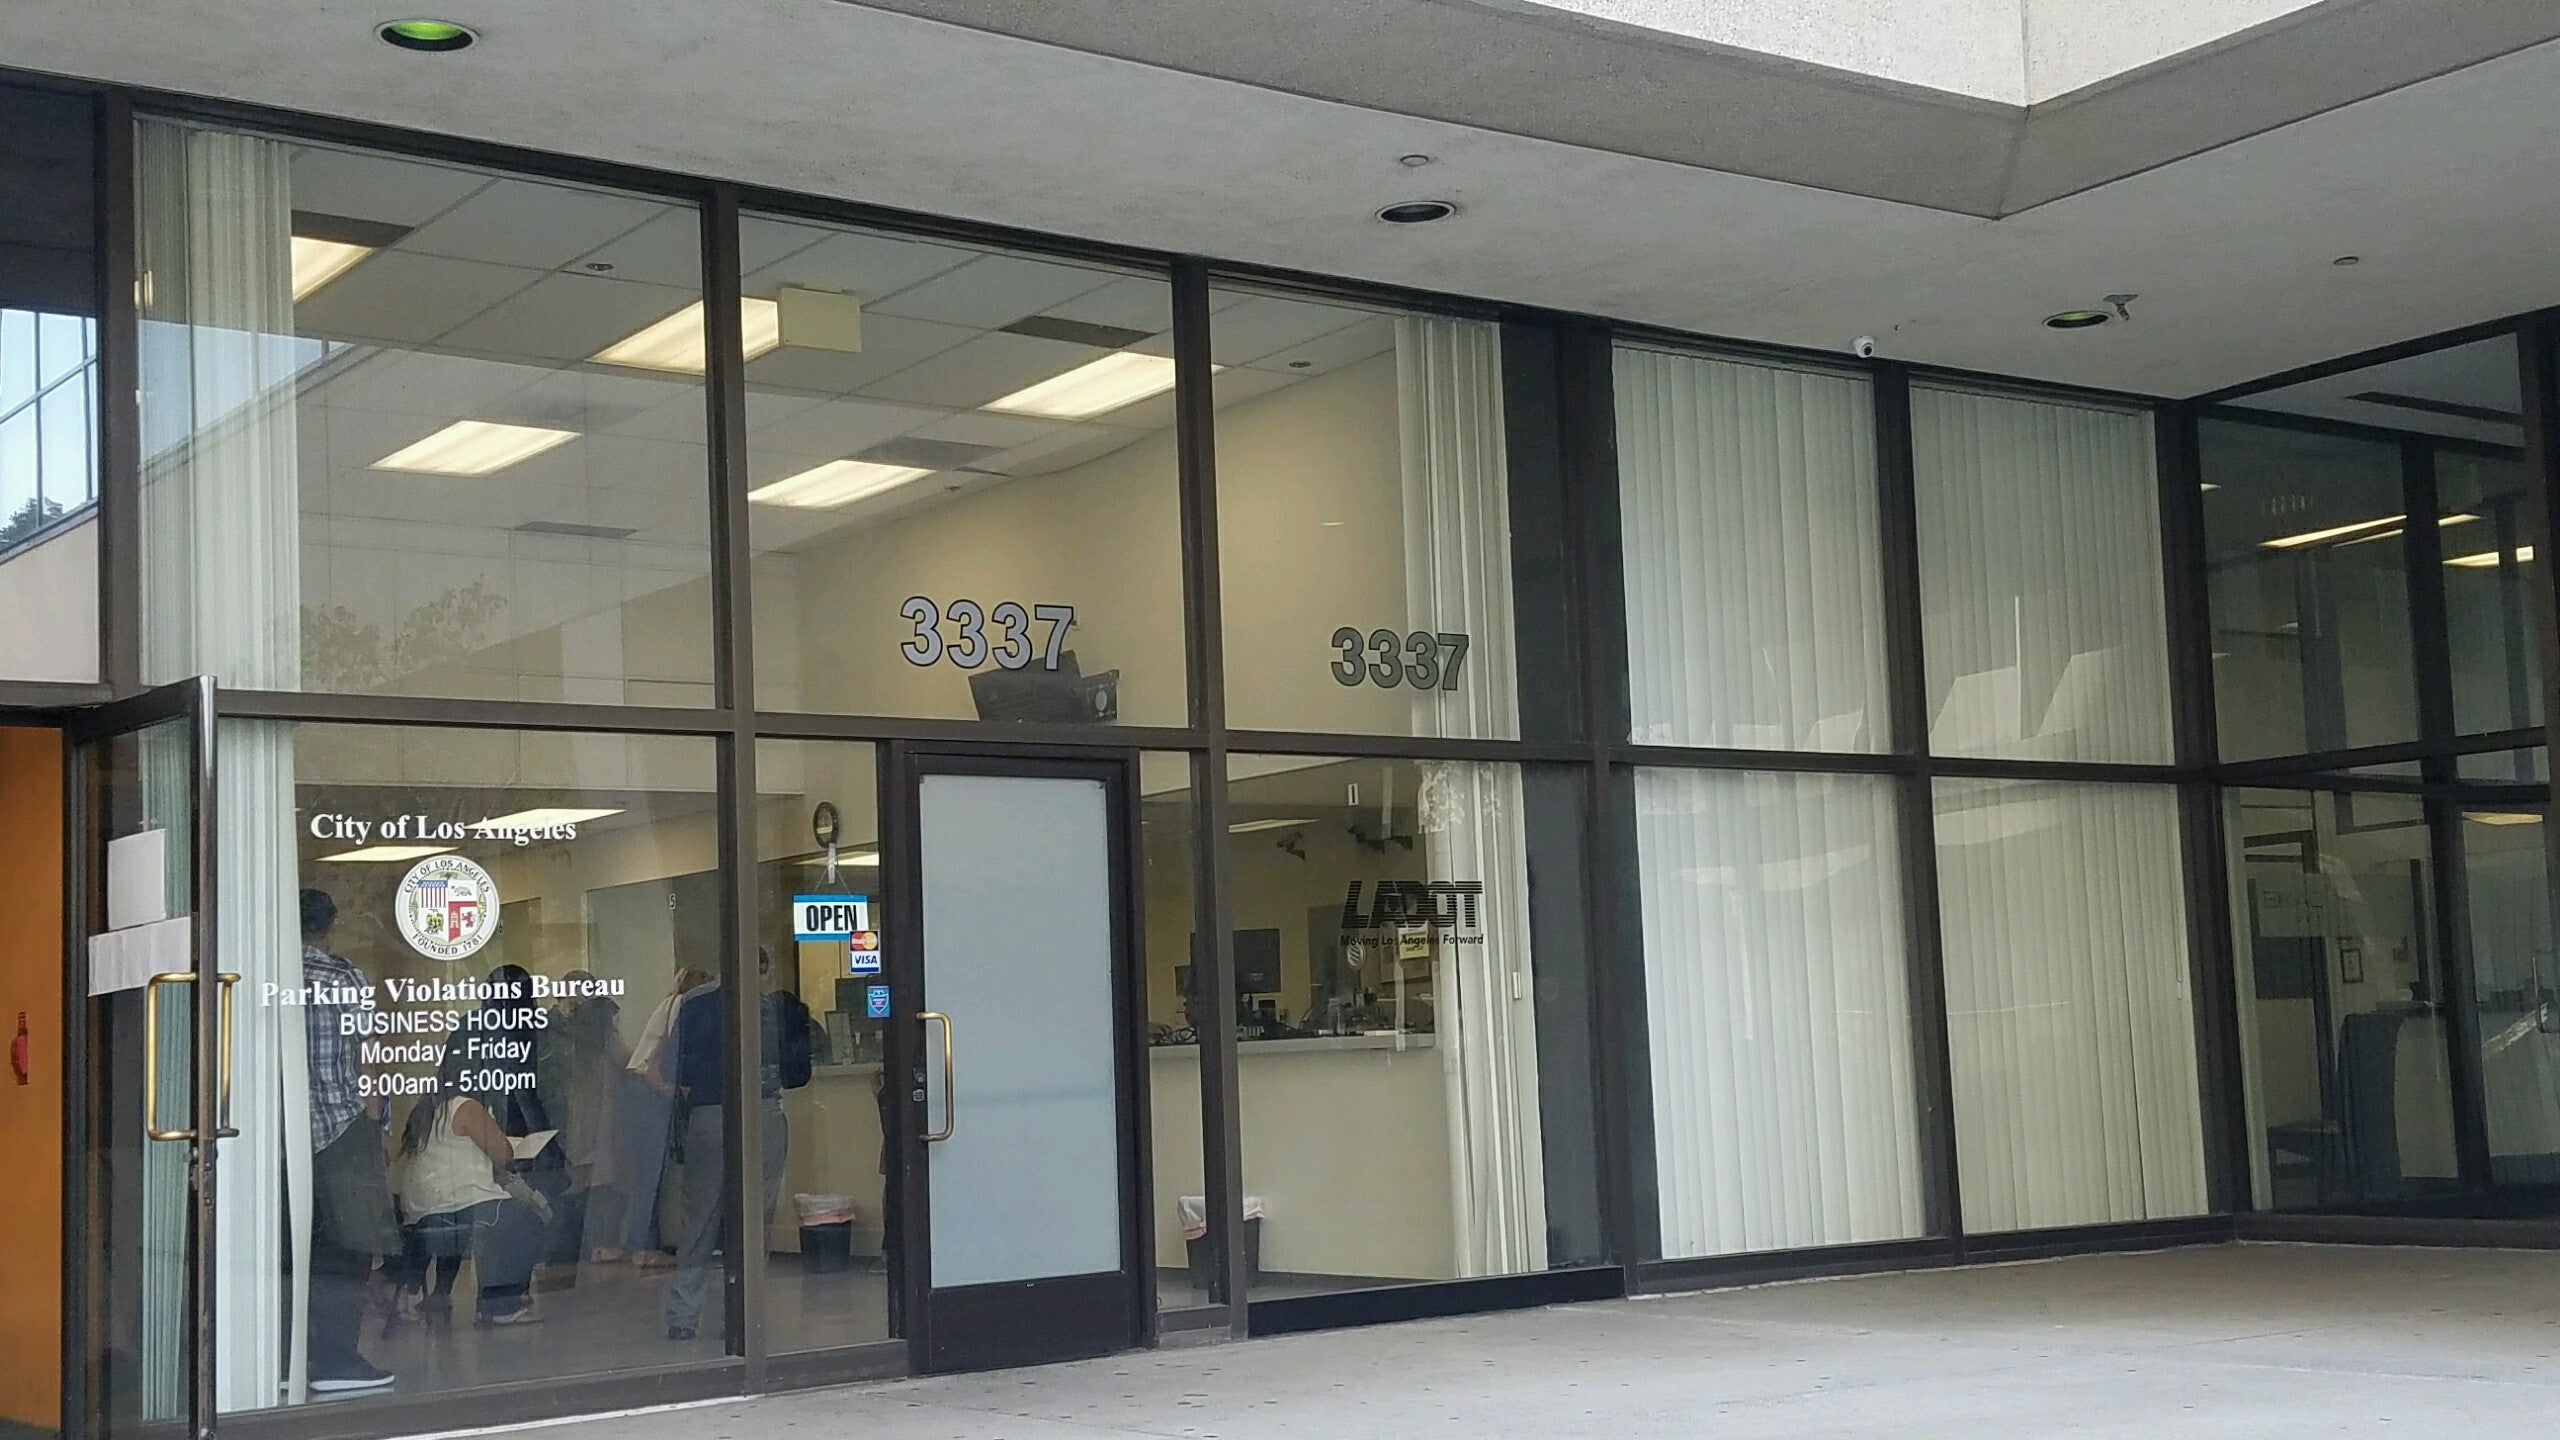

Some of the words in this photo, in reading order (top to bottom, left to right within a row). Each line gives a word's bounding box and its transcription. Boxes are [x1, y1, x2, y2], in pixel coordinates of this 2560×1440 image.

[900, 596, 1074, 671] 3337
[1331, 627, 1469, 690] 3337
[310, 813, 372, 845] City
[380, 815, 411, 839] of
[415, 815, 466, 839] Los
[473, 816, 577, 846] Angeles
[404, 873, 420, 893] CITY
[420, 864, 431, 875] OF
[435, 860, 453, 868] LOS
[456, 862, 490, 893] ANGELES
[805, 904, 858, 931] OPEN
[413, 932, 458, 955] FOUNDED
[463, 934, 483, 951] 1781
[1340, 935, 1379, 949] Moving
[1443, 934, 1484, 945] Forward
[855, 955, 878, 965] VISA
[260, 980, 376, 1010] Parking
[384, 976, 522, 1003] Violations
[530, 975, 625, 999] Bureau
[340, 1010, 460, 1035] BUSINESS
[467, 1007, 549, 1031] HOURS
[361, 1040, 447, 1067] Monday
[467, 1037, 532, 1063] Friday
[358, 1073, 438, 1097] 9:00am
[459, 1068, 536, 1096] 5:00pm
